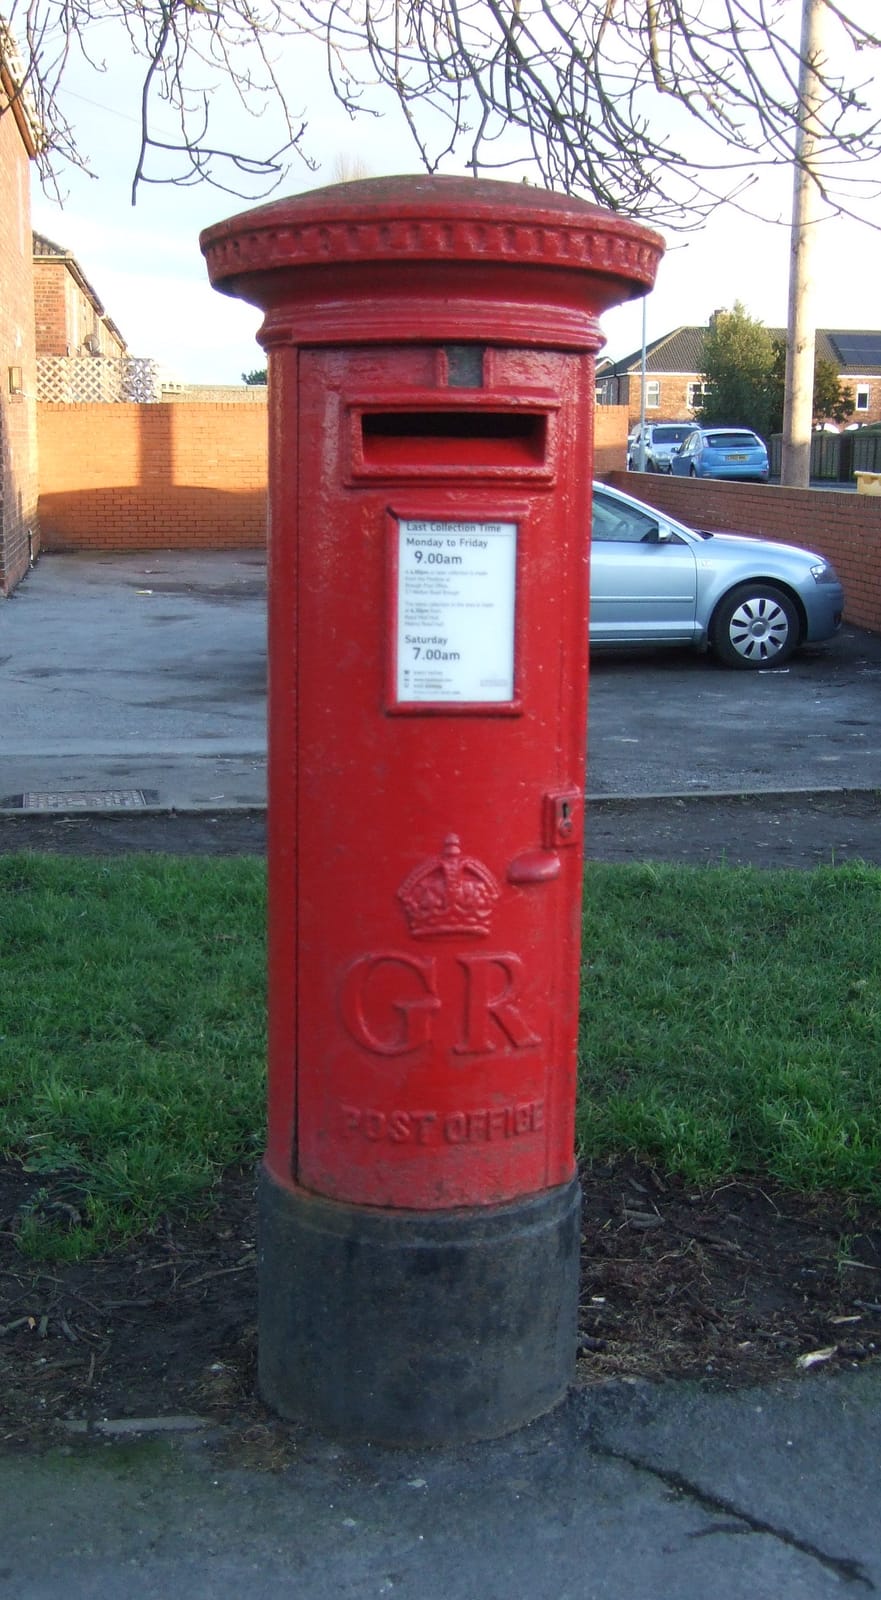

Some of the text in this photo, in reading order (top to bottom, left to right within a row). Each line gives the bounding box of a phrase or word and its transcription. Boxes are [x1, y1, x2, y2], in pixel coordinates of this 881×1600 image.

[406, 522, 502, 533] Last Collection Time
[406, 537, 488, 549] Monday to Friday
[414, 550, 463, 565] 9.00am
[404, 635, 448, 646] Saturday
[412, 647, 460, 661] 7.00am
[338, 951, 543, 1057] GR
[339, 1101, 545, 1145] POST OFFICE
